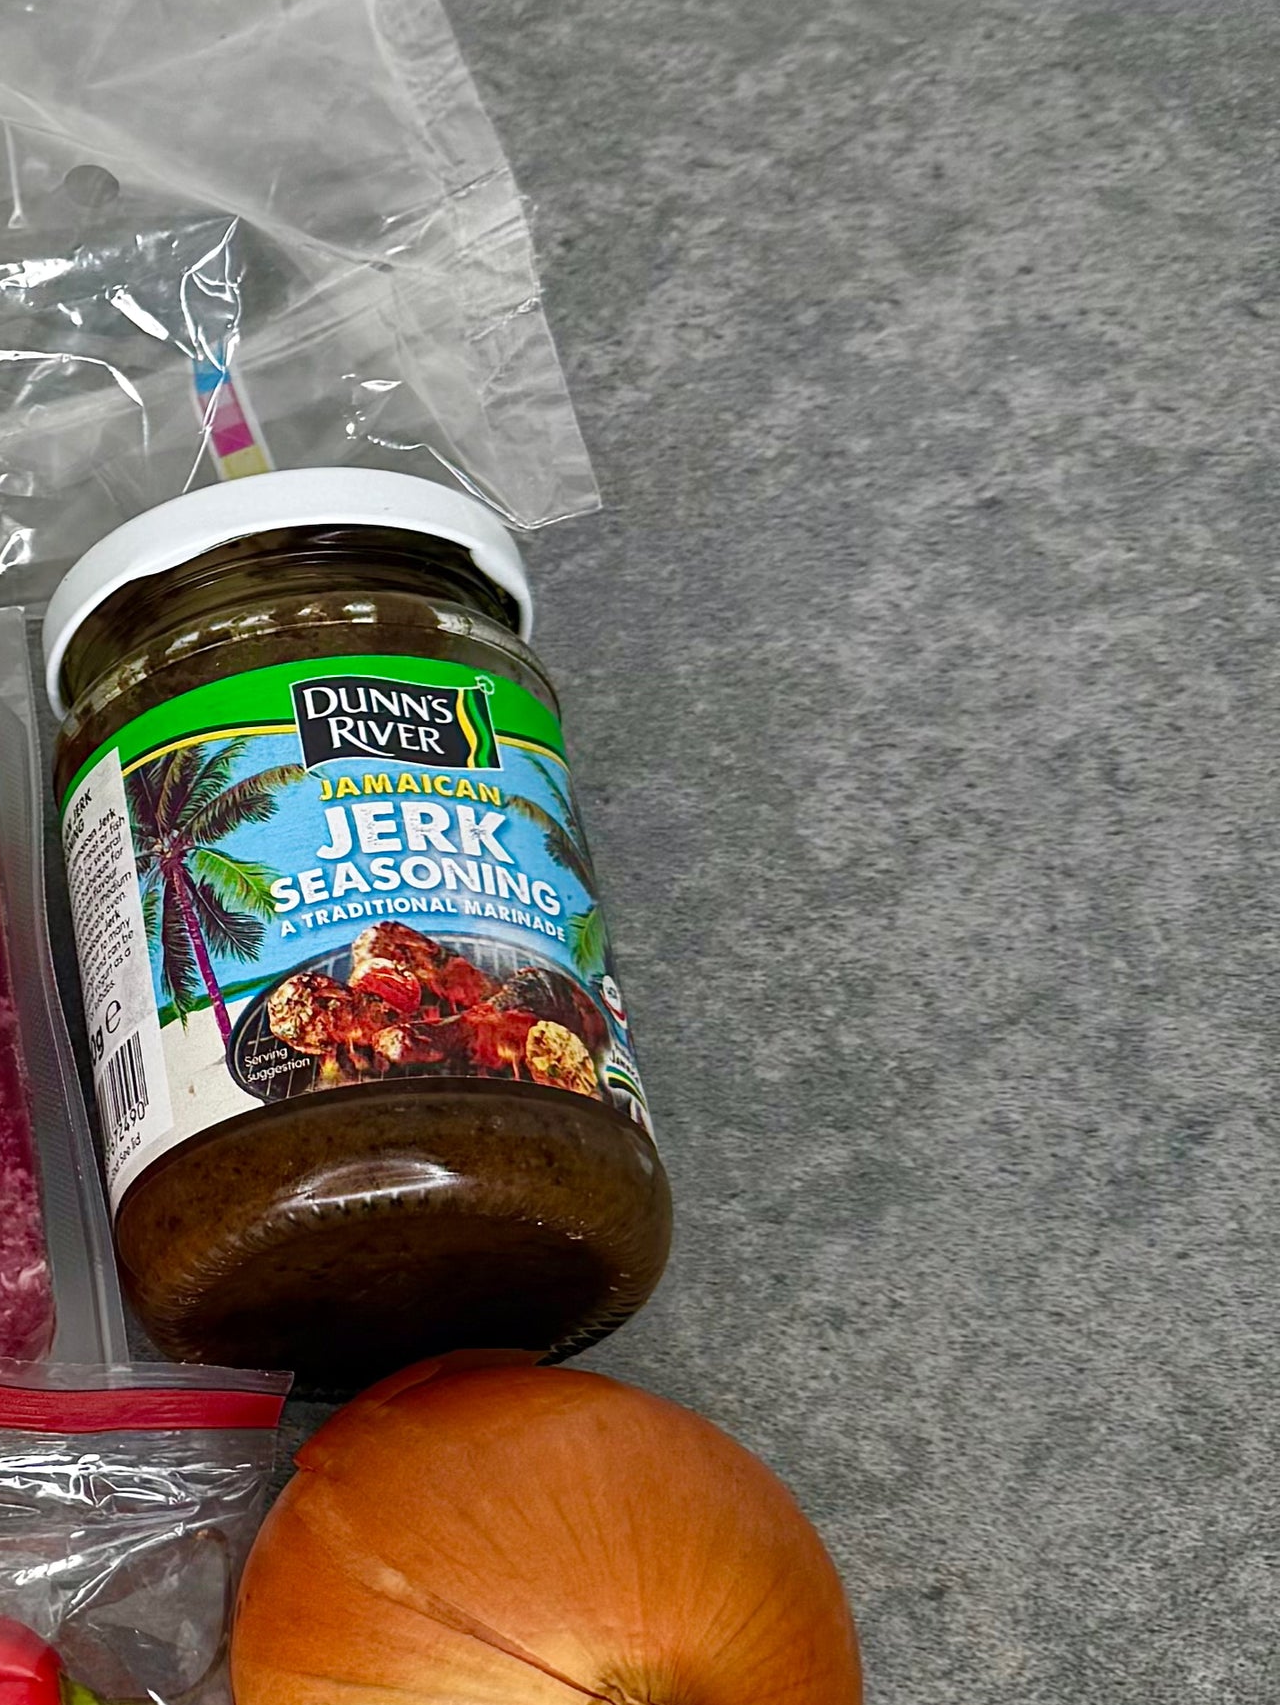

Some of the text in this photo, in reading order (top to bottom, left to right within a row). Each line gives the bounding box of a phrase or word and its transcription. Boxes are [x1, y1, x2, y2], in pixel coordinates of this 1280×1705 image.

[302, 686, 453, 723] DUNN'S
[328, 717, 445, 756] RIVER
[319, 773, 502, 805] JAMAICAN
[316, 801, 514, 865] JERK
[269, 855, 561, 917] SEASONING
[280, 896, 566, 942] A TRADITIONAL MARINADE
[244, 1048, 287, 1067] Serving
[247, 1058, 310, 1082] suggestion
